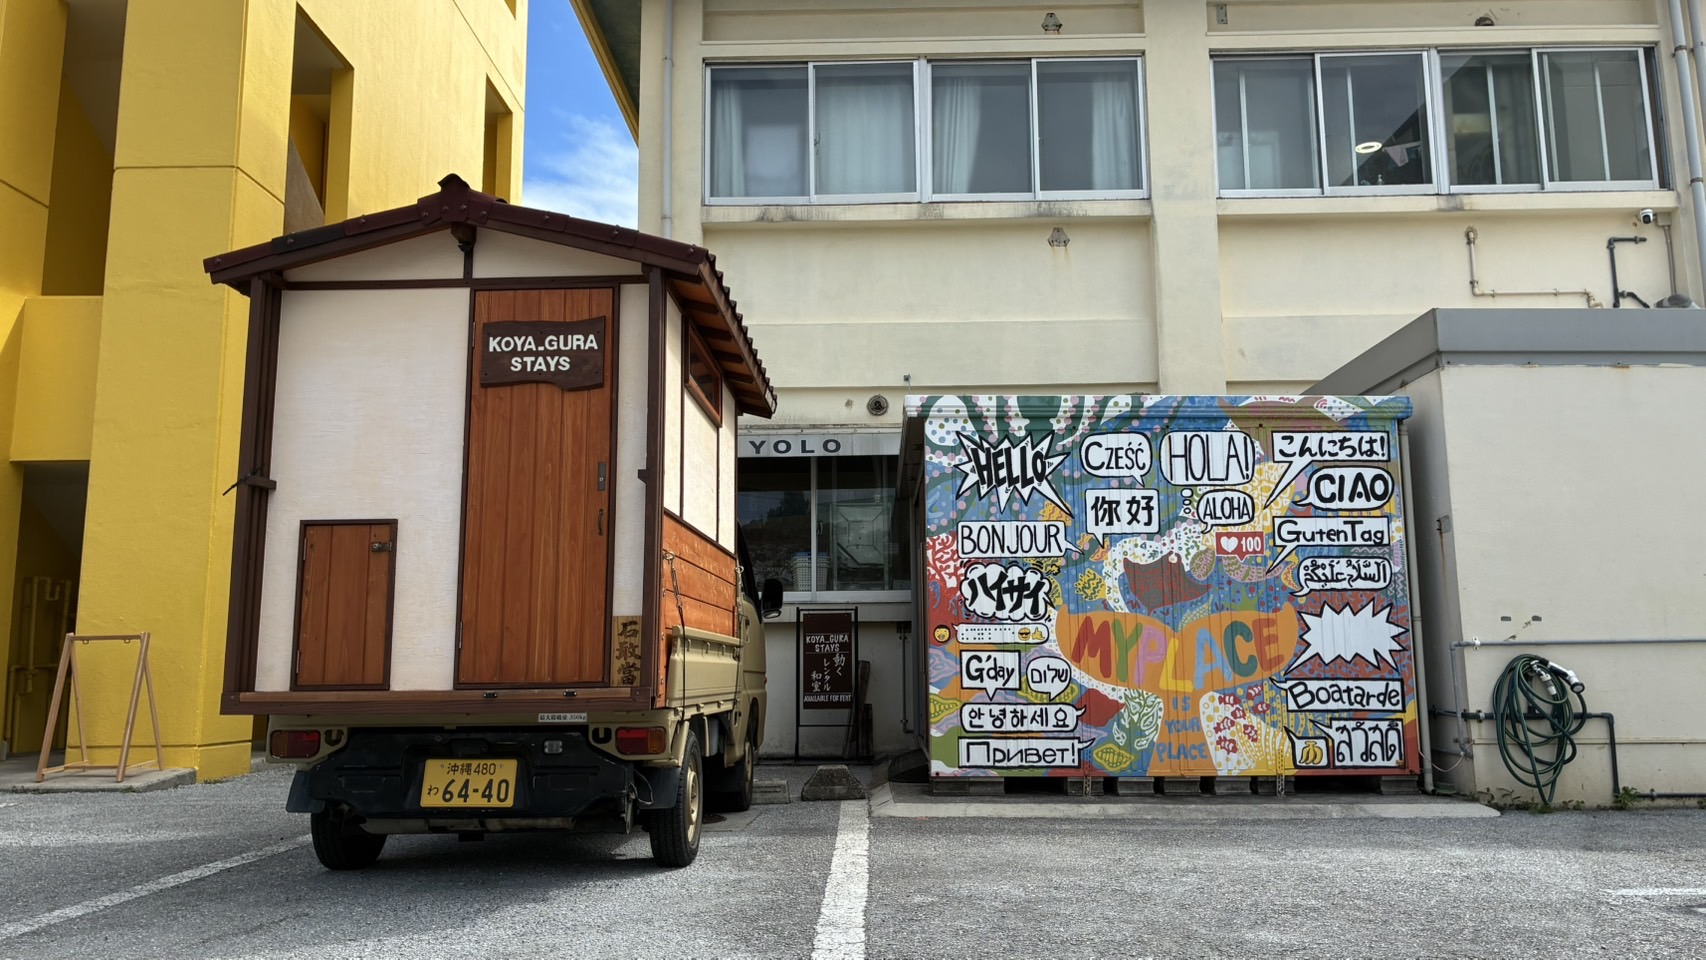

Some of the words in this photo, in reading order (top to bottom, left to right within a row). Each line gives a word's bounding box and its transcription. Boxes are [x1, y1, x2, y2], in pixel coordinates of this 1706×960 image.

[510, 355, 571, 372] STAYS
[748, 438, 842, 455] YOLO
[1168, 433, 1251, 482] HOLA!
[970, 445, 1047, 490] HELLO
[1314, 472, 1390, 502] CIAO
[1090, 495, 1155, 527] 你好
[1203, 496, 1251, 521] ALOHA
[961, 524, 1064, 555] BONJOUR
[1240, 536, 1262, 553] 100
[967, 570, 1047, 616] ハイサイ
[814, 643, 840, 653] STAYS
[823, 657, 832, 692] レンタル
[832, 652, 846, 676] 動く
[965, 654, 1015, 687] G'day
[1030, 664, 1069, 684] שלום
[810, 670, 823, 693] 和室
[1172, 696, 1191, 712] IS
[1288, 681, 1401, 709] Boatarde
[968, 706, 1070, 729] 안녕하세요
[1164, 716, 1201, 735] YOUR
[1157, 741, 1209, 763] PLACE
[426, 784, 439, 796] わ
[441, 778, 510, 803] 64-40
